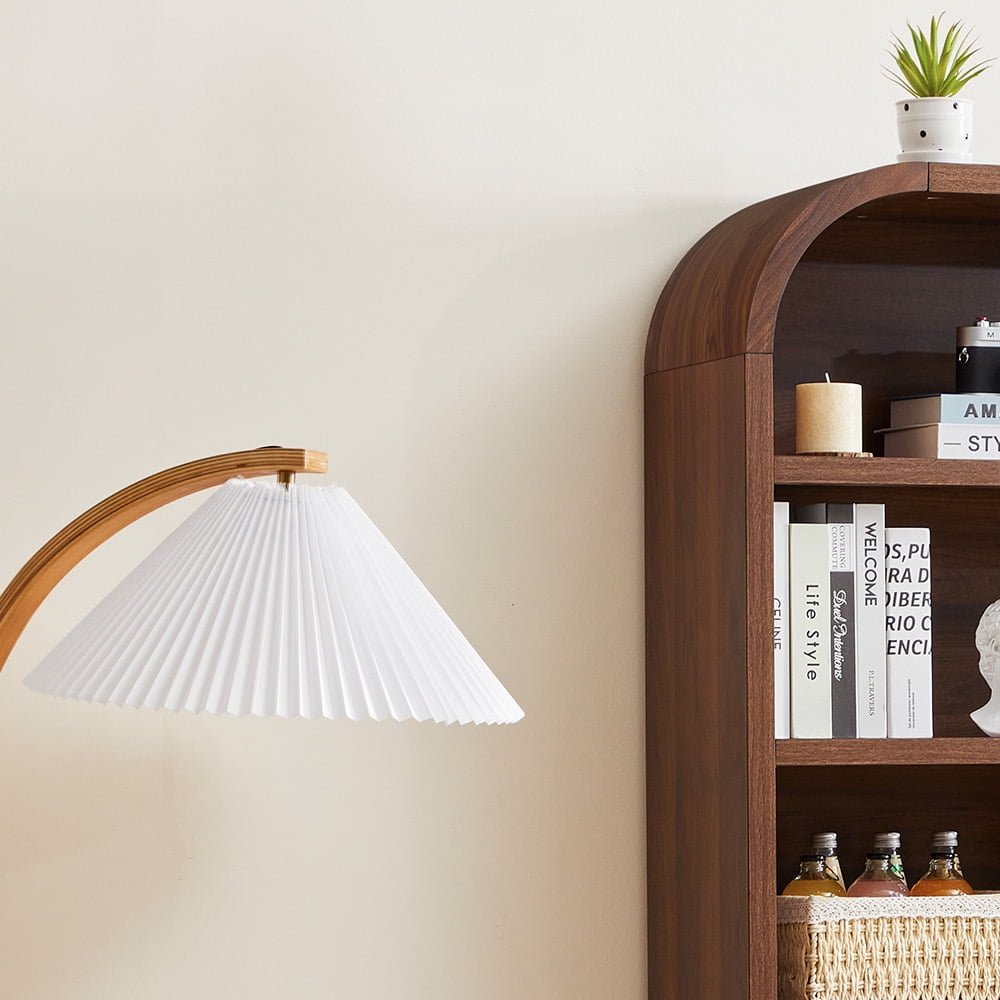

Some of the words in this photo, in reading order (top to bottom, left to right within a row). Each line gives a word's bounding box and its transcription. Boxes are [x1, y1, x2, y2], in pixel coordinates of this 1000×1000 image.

[831, 527, 839, 569] COMMUTE
[839, 525, 847, 569] COVERING
[864, 522, 878, 606] WELCOME
[806, 585, 819, 619] Life
[803, 630, 819, 680] Style
